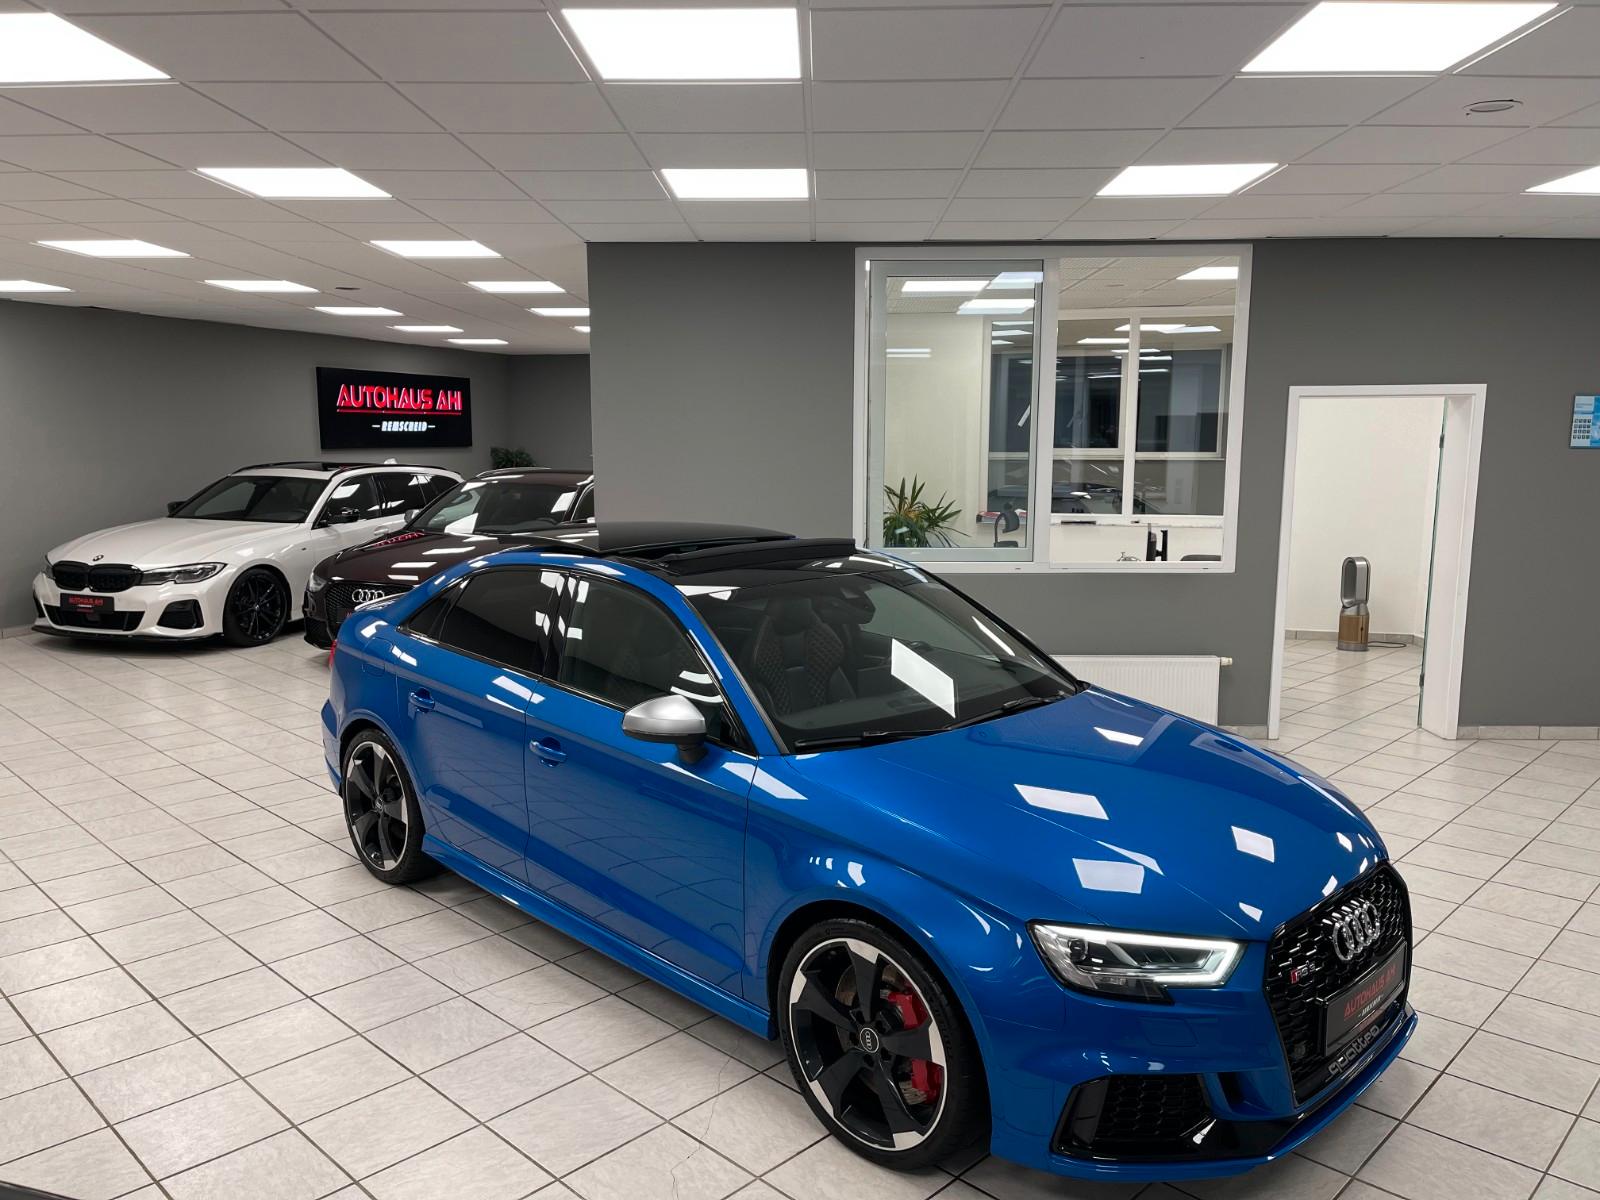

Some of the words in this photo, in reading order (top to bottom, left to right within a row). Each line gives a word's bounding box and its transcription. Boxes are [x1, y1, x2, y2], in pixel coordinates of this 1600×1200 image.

[336, 384, 433, 410] AUTOHAUS
[436, 389, 463, 411] AHI
[381, 420, 428, 432] REMSCHEID
[1344, 974, 1386, 1018] AUTOHAUS
[1328, 1025, 1380, 1075] quattro
